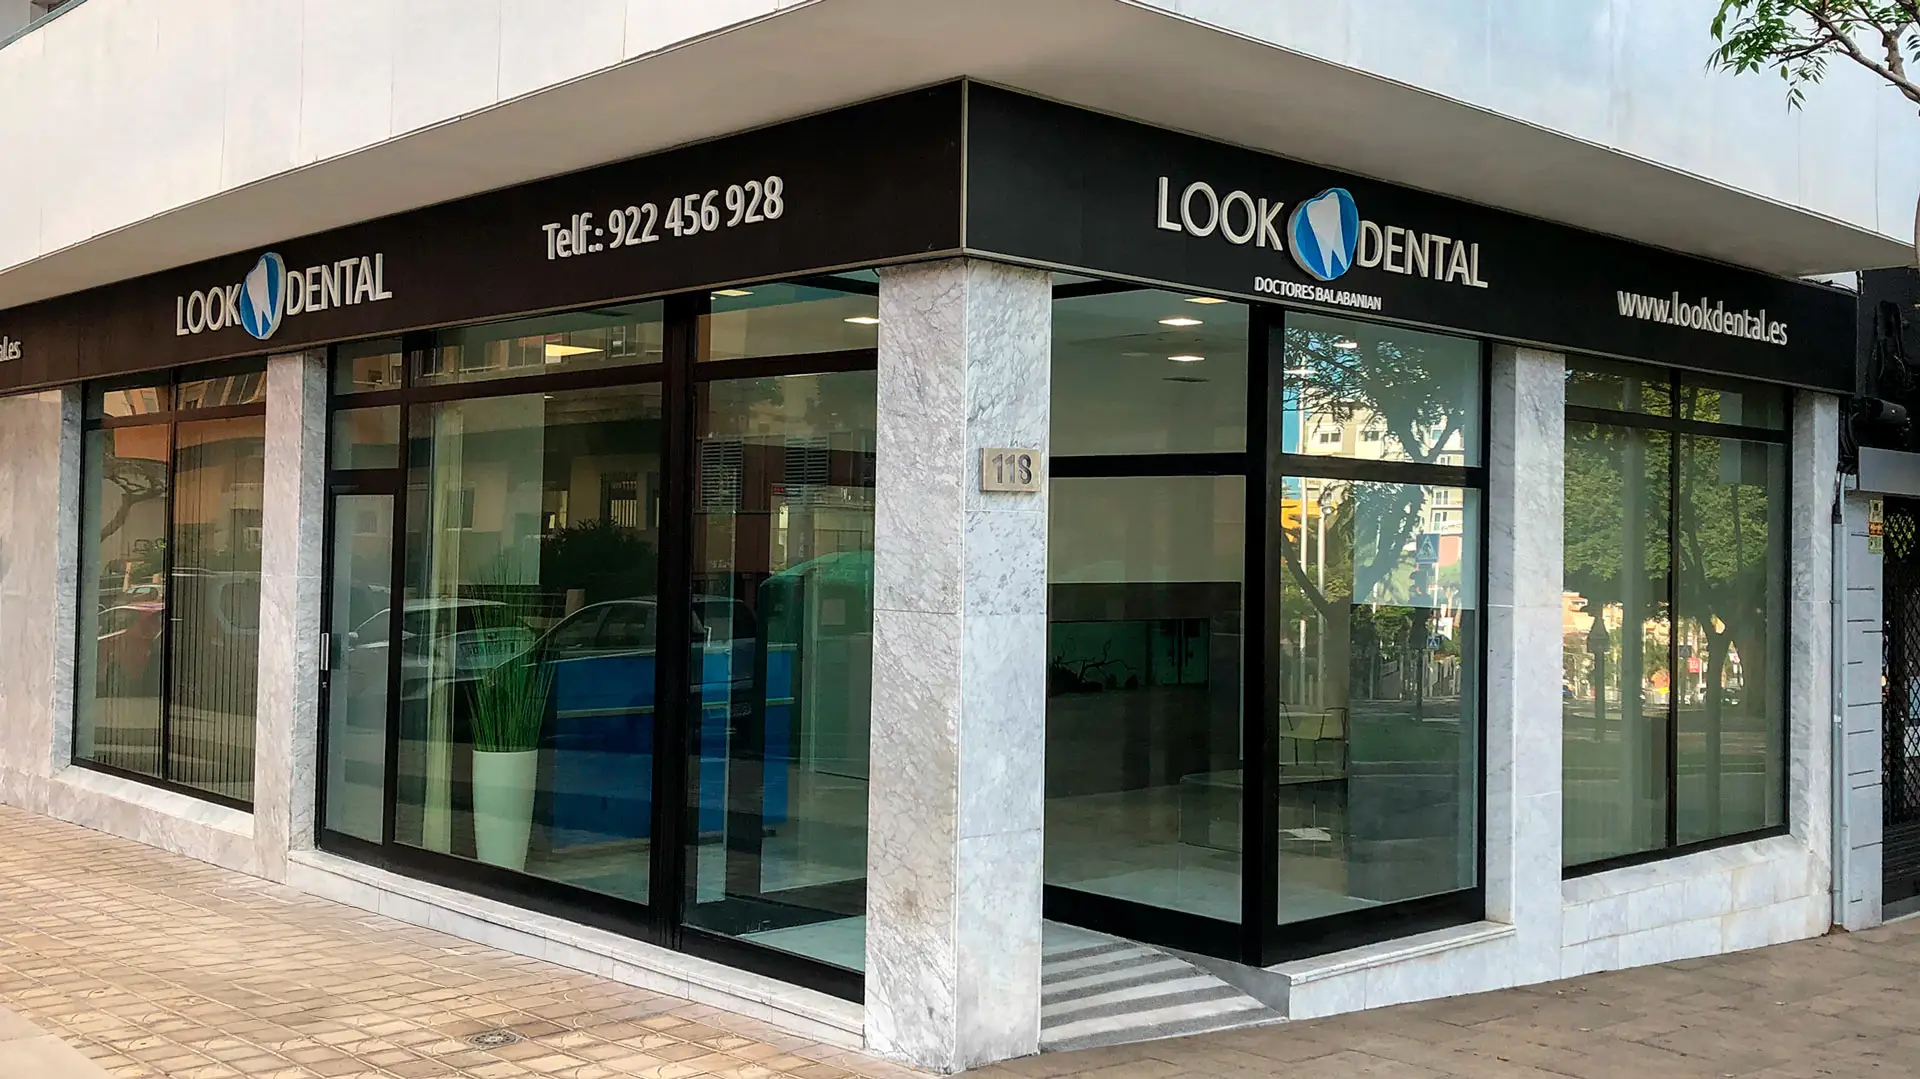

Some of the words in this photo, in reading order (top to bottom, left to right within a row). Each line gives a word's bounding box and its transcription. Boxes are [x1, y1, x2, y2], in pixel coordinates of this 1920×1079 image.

[608, 202, 659, 249] 922
[664, 189, 720, 237] 456
[725, 175, 784, 228] 928
[1157, 176, 1284, 251] LOOK
[1356, 220, 1488, 289] DENTAL
[176, 284, 241, 337] LOOK
[286, 252, 393, 316] DENTAL
[1254, 275, 1315, 301] DOCTORES
[1315, 287, 1382, 311] BALABANIAN
[1616, 290, 1788, 346] www.lookdental.es
[991, 453, 1032, 485] 118
